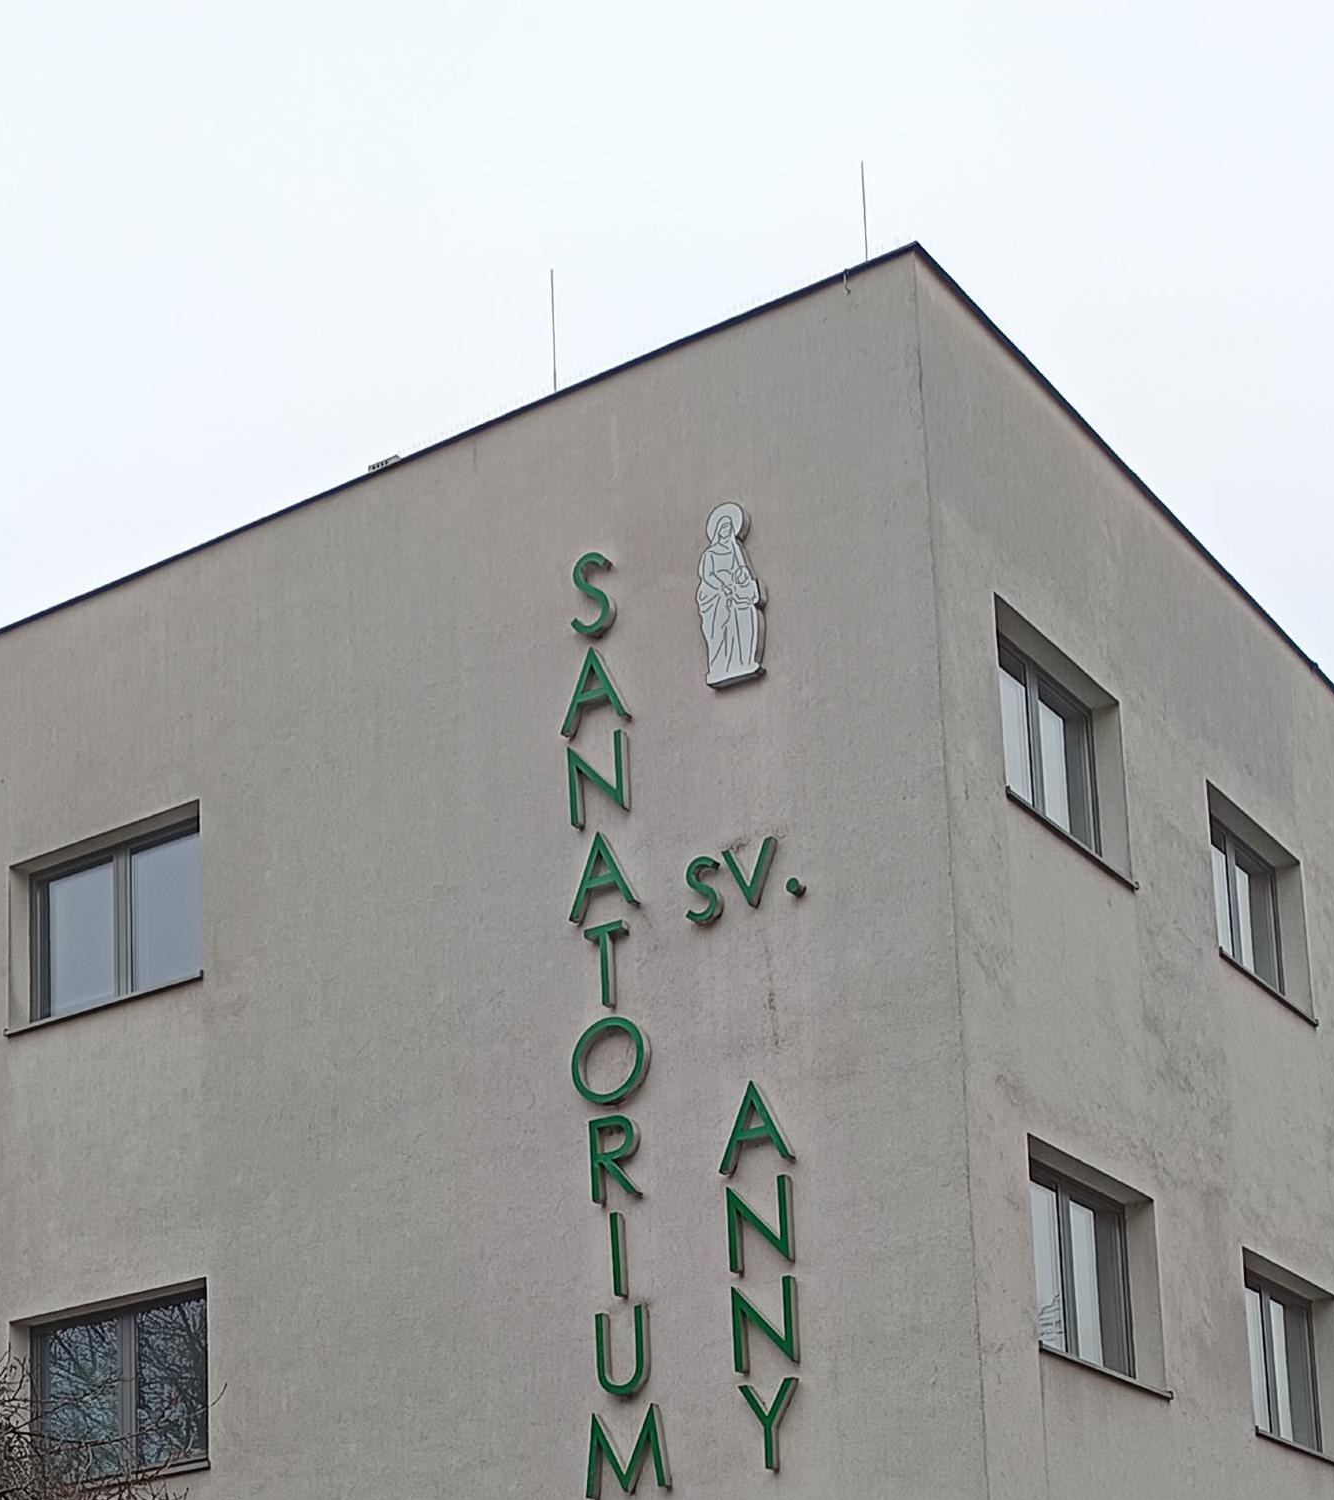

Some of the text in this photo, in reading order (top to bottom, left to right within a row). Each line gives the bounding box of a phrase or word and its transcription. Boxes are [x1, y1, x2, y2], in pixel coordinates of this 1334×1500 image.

[562, 551, 671, 1500] SANATORIUM
[685, 836, 805, 926] SV.
[719, 1081, 798, 1471] ANNY
